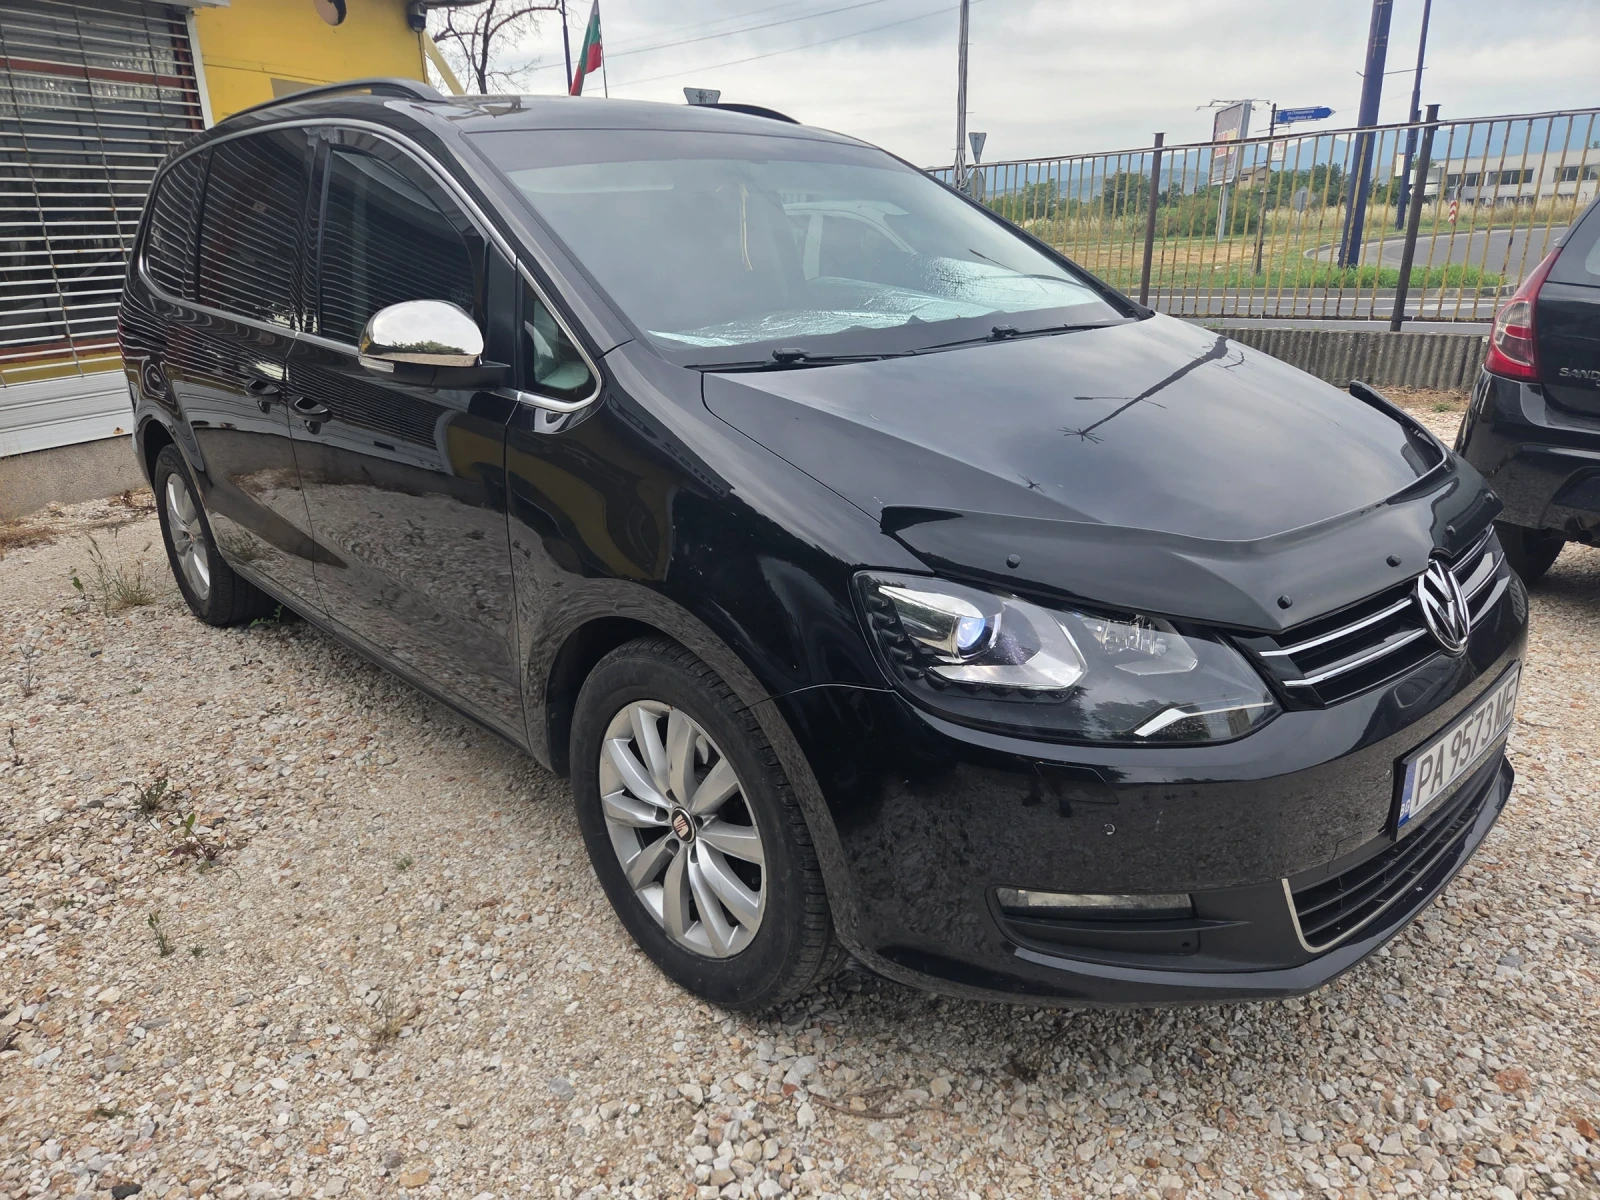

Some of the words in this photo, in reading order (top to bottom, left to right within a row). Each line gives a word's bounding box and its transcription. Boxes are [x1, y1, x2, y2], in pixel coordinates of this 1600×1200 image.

[1415, 743, 1444, 808] PA
[1450, 700, 1494, 778] 9573
[1400, 799, 1411, 816] BG
